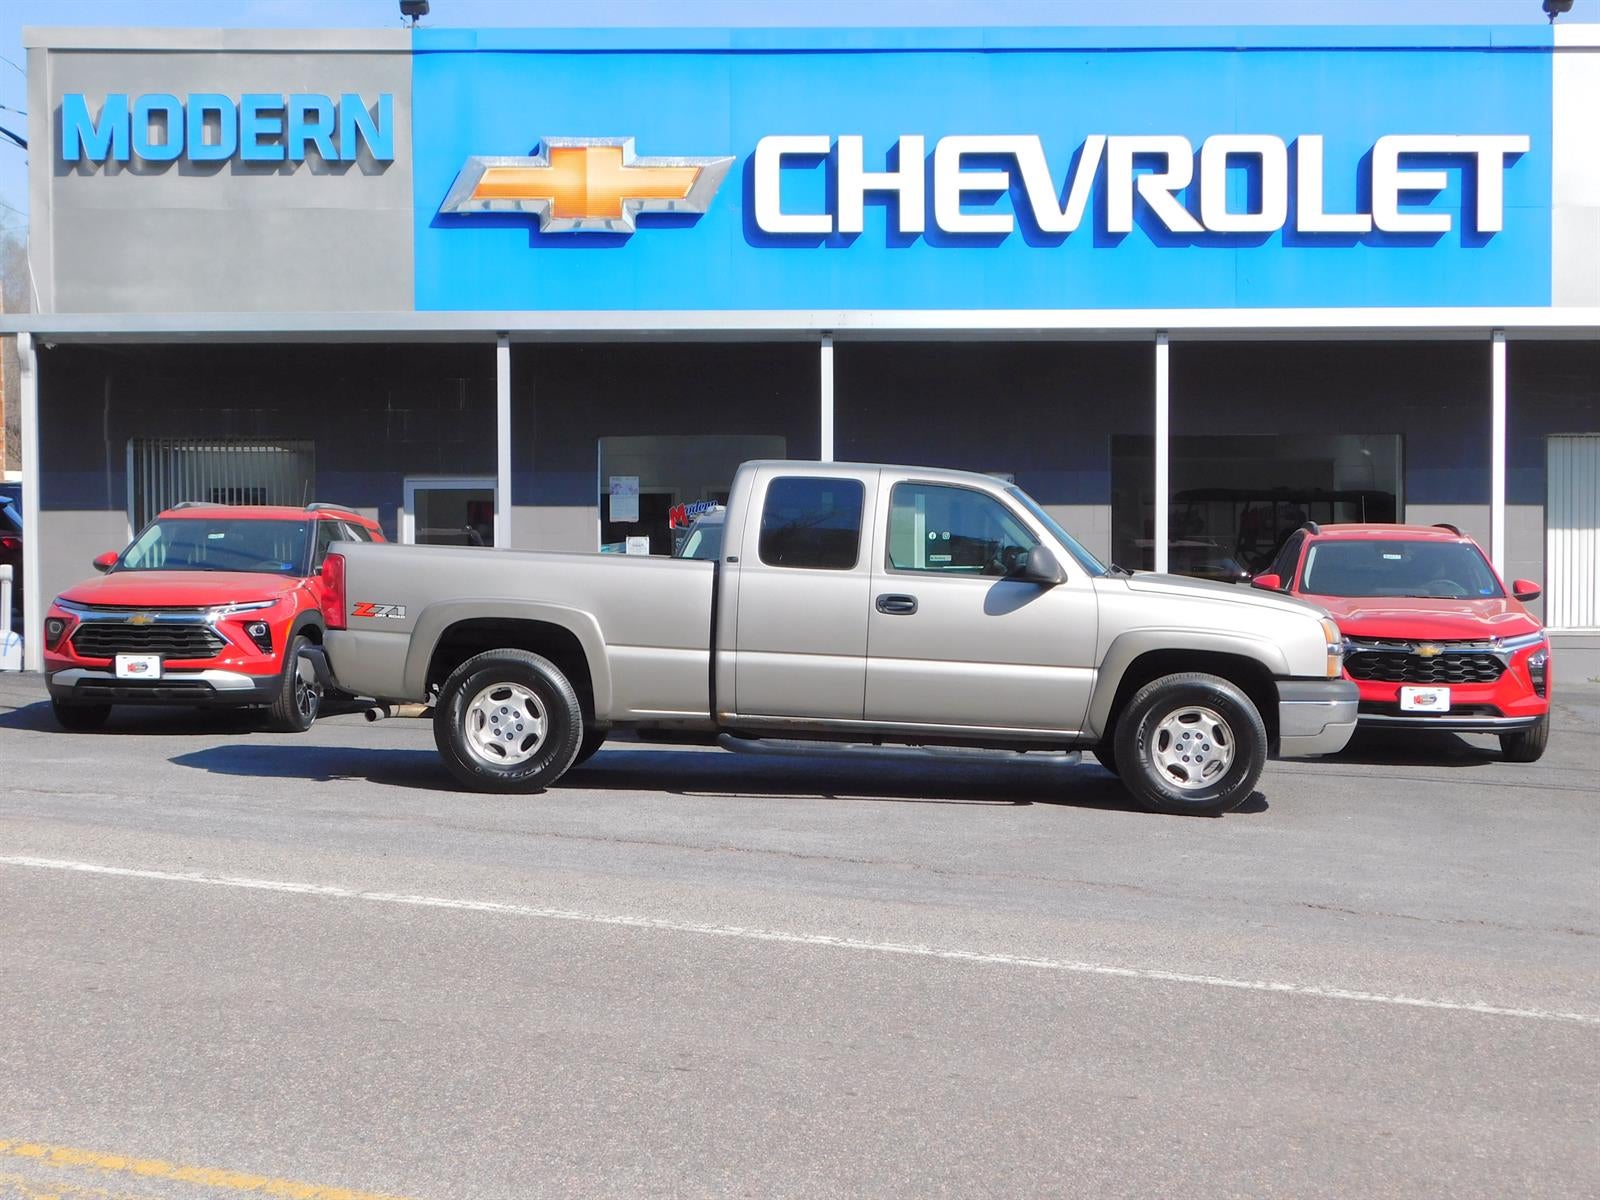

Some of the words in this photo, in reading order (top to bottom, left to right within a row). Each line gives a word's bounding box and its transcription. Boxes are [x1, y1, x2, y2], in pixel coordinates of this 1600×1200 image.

[62, 93, 394, 162] MODERN
[754, 134, 1530, 233] CHEVROLET
[351, 602, 407, 617] Z71
